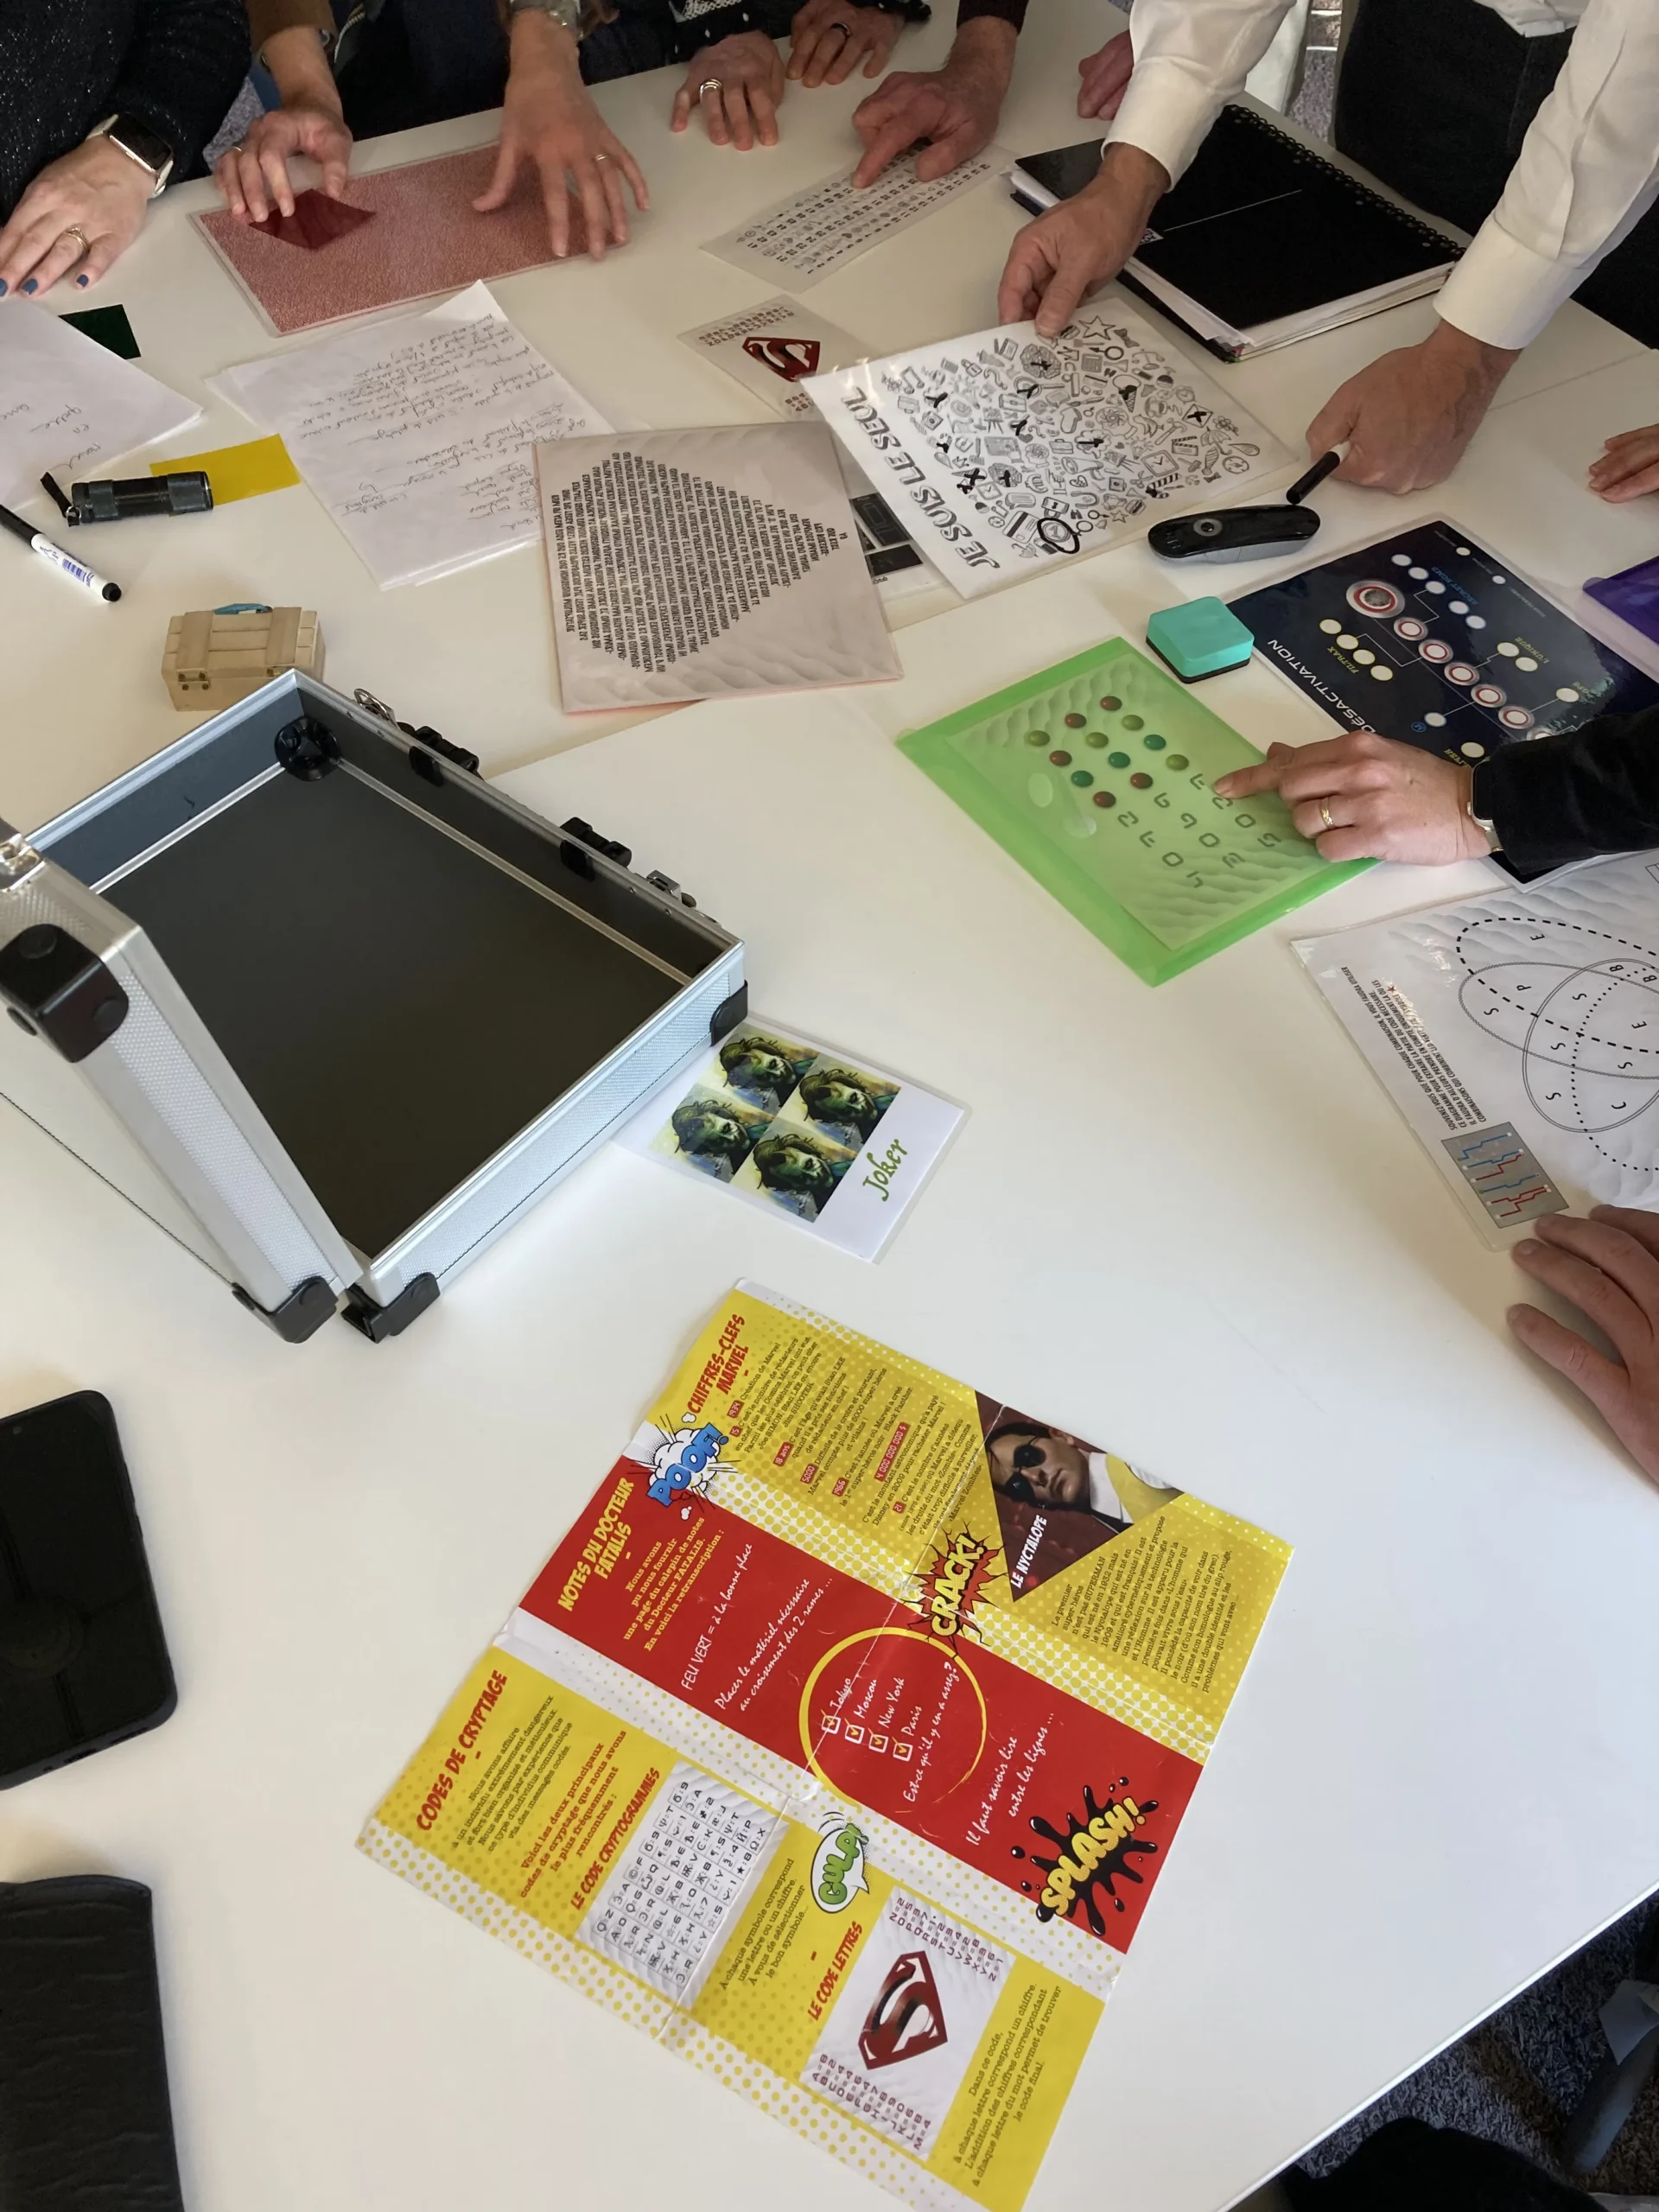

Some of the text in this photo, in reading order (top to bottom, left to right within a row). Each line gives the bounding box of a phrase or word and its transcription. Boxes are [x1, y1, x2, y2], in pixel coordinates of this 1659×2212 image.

[841, 385, 1001, 569] JE SUIS LE SEUL
[1268, 640, 1375, 737] DÉSACTIVATION
[863, 1139, 908, 1202] Joker
[688, 1315, 744, 1413] CHIFFRES-CLEFS
[716, 1344, 748, 1395] MARVEL
[728, 1342, 781, 1417] 1934 Création de Marvel
[646, 1423, 730, 1510] POOF!
[801, 1465, 816, 1483] 5000
[879, 1459, 891, 1473] 000
[885, 1444, 897, 1459] 000
[892, 1430, 904, 1445] 000
[557, 1478, 633, 1611] NOTES DU DOCTEUR
[594, 1522, 631, 1578] FATALIS
[623, 1516, 705, 1640] une page du calepin de notes
[625, 1541, 662, 1592] Nous avons
[631, 1538, 677, 1608] pu nous fournir
[735, 1543, 753, 1571] place
[1010, 1516, 1046, 1589] LE NYCTALOPE
[643, 1539, 705, 1631] du Docteur FATALIS.
[644, 1535, 721, 1651] En voici la retranscription
[711, 1615, 721, 1625] à
[713, 1603, 728, 1614] la
[719, 1570, 741, 1601] bonne
[927, 1532, 985, 1637] CRACK!
[1051, 1583, 1072, 1627] Le premier
[1062, 1585, 1084, 1630] super-héros
[1071, 1556, 1106, 1636] n'est pas SUPERMAN
[680, 1663, 700, 1691] FEU
[690, 1634, 712, 1663] VERT
[714, 1579, 810, 1710] Placer le matériel nécessaire
[740, 1587, 824, 1712] au croisement des 2 rames
[830, 1677, 853, 1710] Tokyo
[853, 1679, 877, 1719] Moscou
[877, 1677, 905, 1729] New York
[900, 1706, 922, 1737] Paris
[902, 1661, 965, 1802] Est-ce qu'il y en a assez?
[416, 1671, 506, 1830] CODES DE CRYPTAGE
[1008, 1726, 1048, 1817] entre les lignes
[519, 1730, 626, 1898] codes de cryptage que nous avons
[520, 1744, 603, 1869] Voici les deux principaux
[550, 1767, 618, 1872] le plus fréquemment
[576, 1800, 613, 1857] rencontrés
[965, 1736, 1018, 1846] Il faut savoir lire
[570, 1769, 658, 1910] LE CODE CRYPTOGRAMMES
[817, 1821, 870, 1904] GULP!
[1041, 1796, 1147, 1915] SPLASH!
[719, 1858, 794, 1991] À chaque symbole correspond
[807, 1921, 862, 2021] LE CODE LETTRES
[968, 2032, 1004, 2097] Dans ce code,
[1013, 2062, 1044, 2122] le code final.
